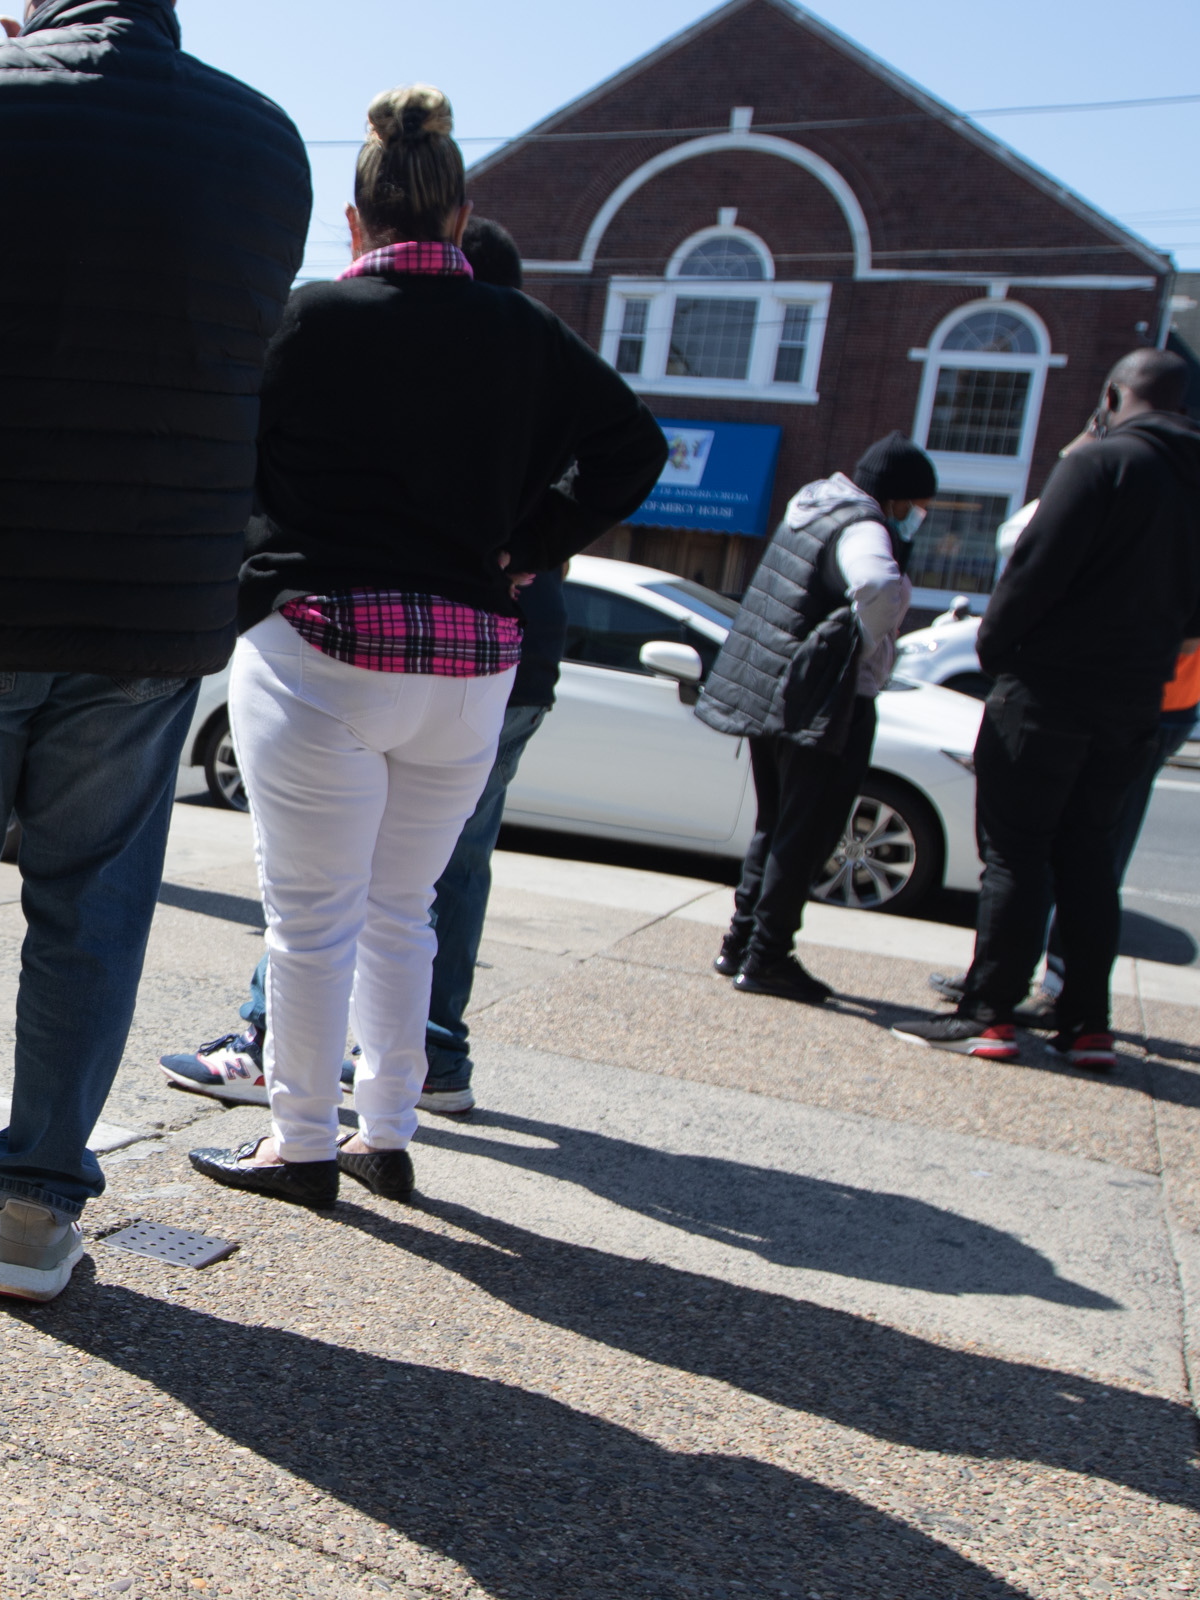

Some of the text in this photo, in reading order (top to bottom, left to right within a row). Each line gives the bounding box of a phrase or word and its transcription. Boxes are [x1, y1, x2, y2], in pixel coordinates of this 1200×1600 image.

[658, 502, 696, 514] MERCY
[699, 504, 734, 518] HOUSE
[223, 1058, 251, 1080] N
